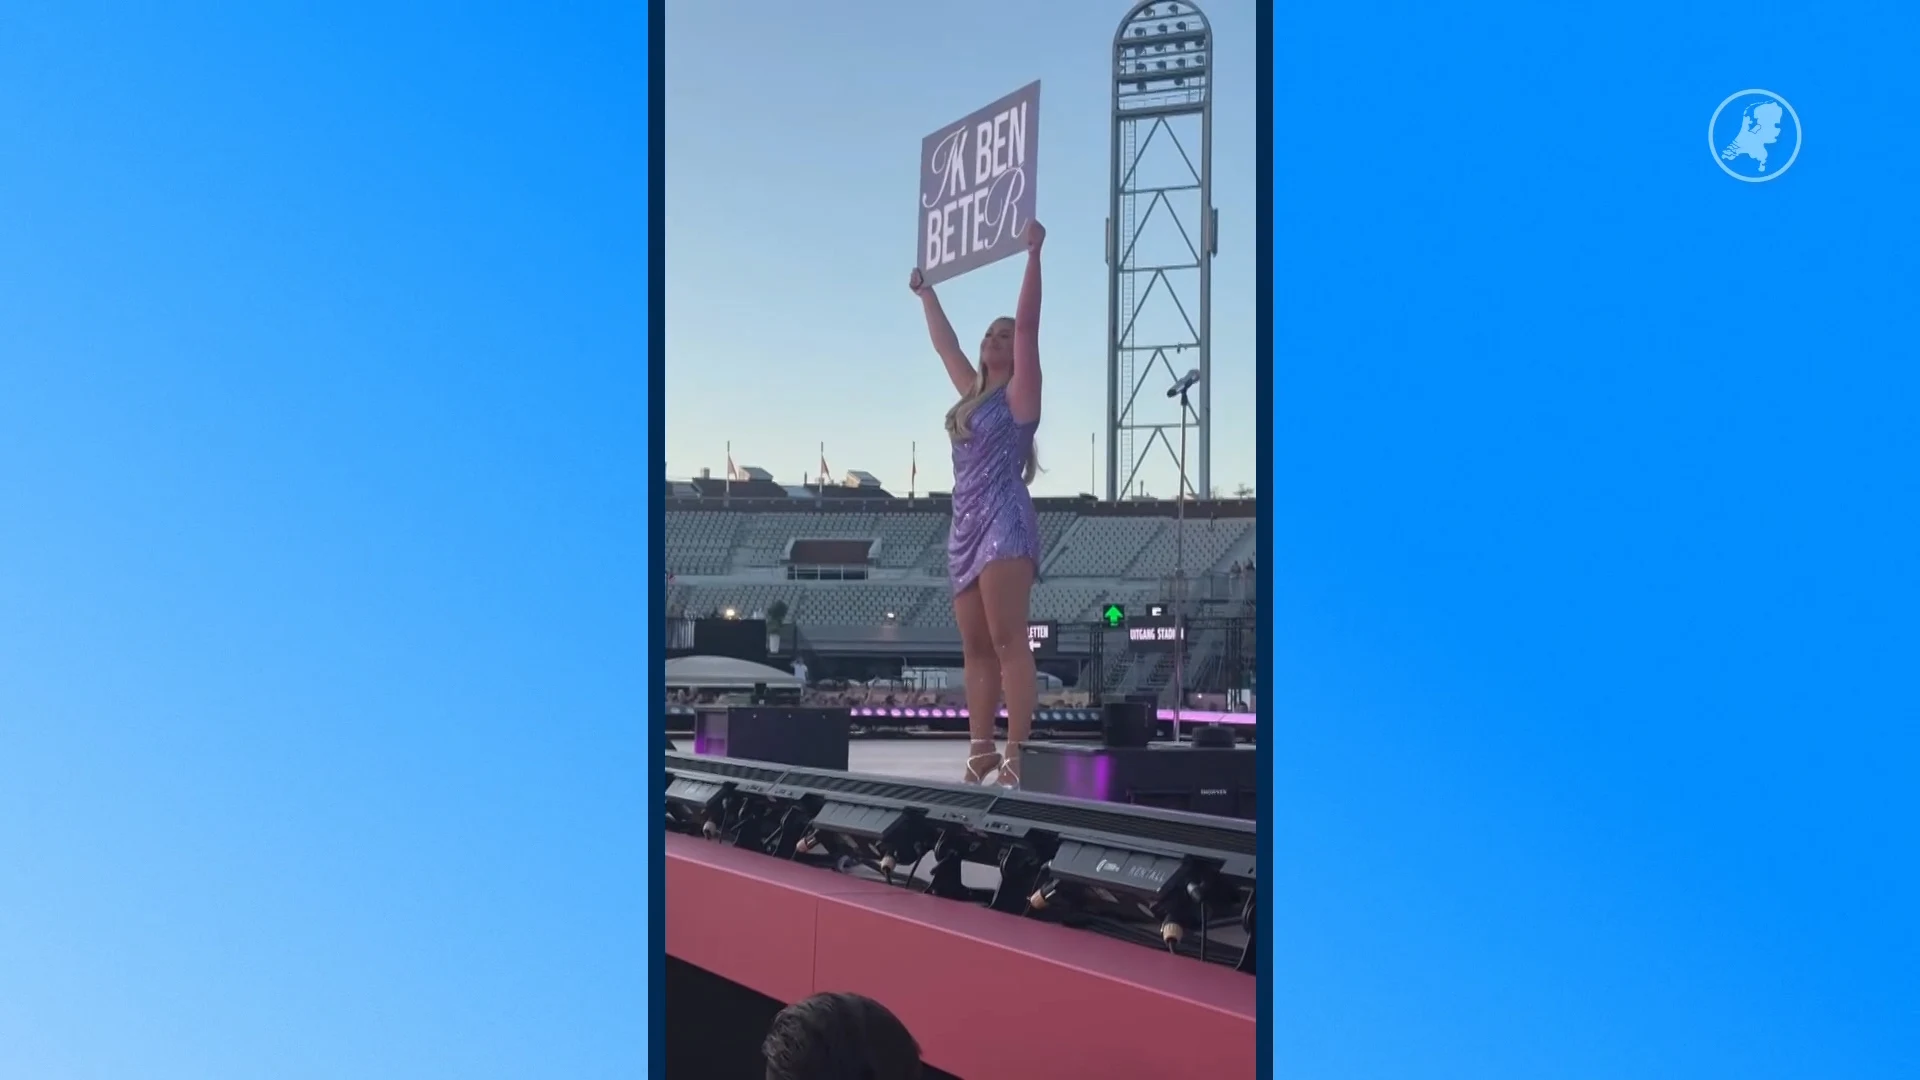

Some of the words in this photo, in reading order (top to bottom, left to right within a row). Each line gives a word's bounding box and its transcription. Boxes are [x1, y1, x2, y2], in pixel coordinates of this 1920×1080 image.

[922, 125, 968, 208] IK
[975, 101, 1027, 186] BEN
[926, 162, 1028, 270] BETER
[1130, 627, 1155, 640] UITGANG
